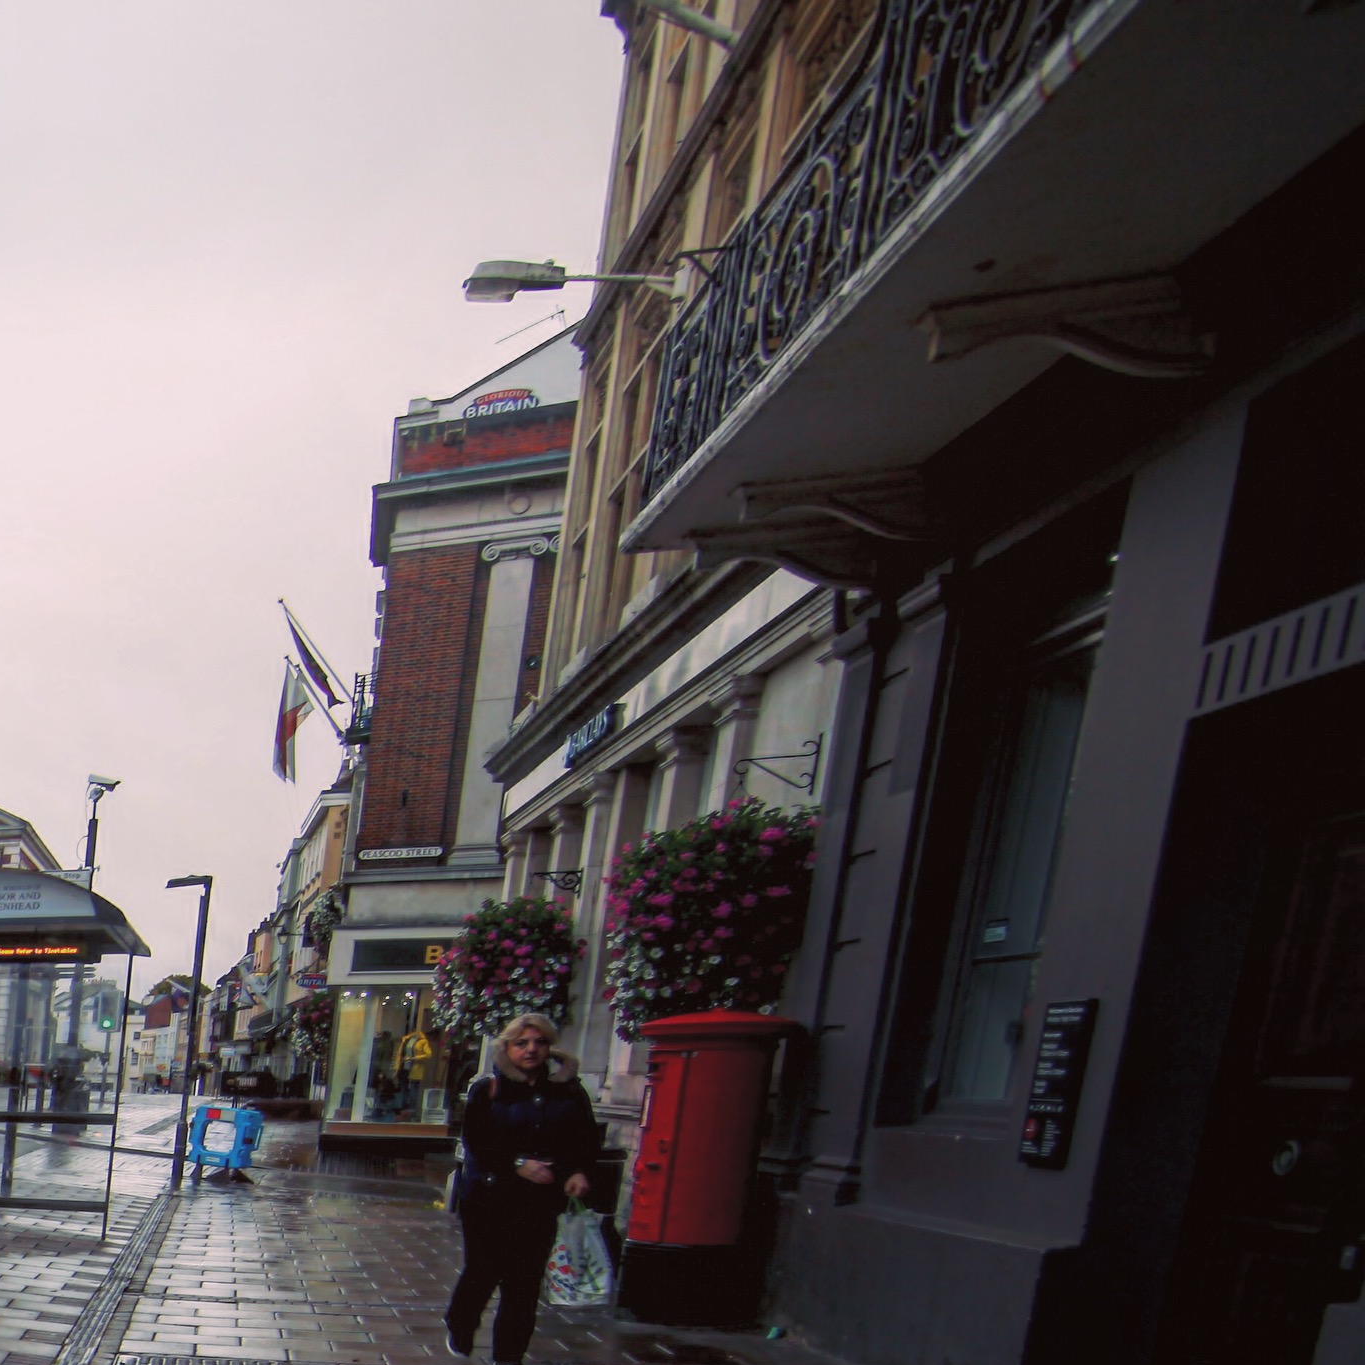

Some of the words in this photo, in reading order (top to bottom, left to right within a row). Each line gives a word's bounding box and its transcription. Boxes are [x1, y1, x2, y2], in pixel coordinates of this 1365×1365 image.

[475, 389, 529, 405] GLORIOUS
[465, 396, 537, 419] BRITAIN
[362, 849, 403, 859] PEASCOD
[405, 848, 439, 857] STREET
[19, 892, 41, 901] AND
[297, 978, 326, 986] BRITAI
